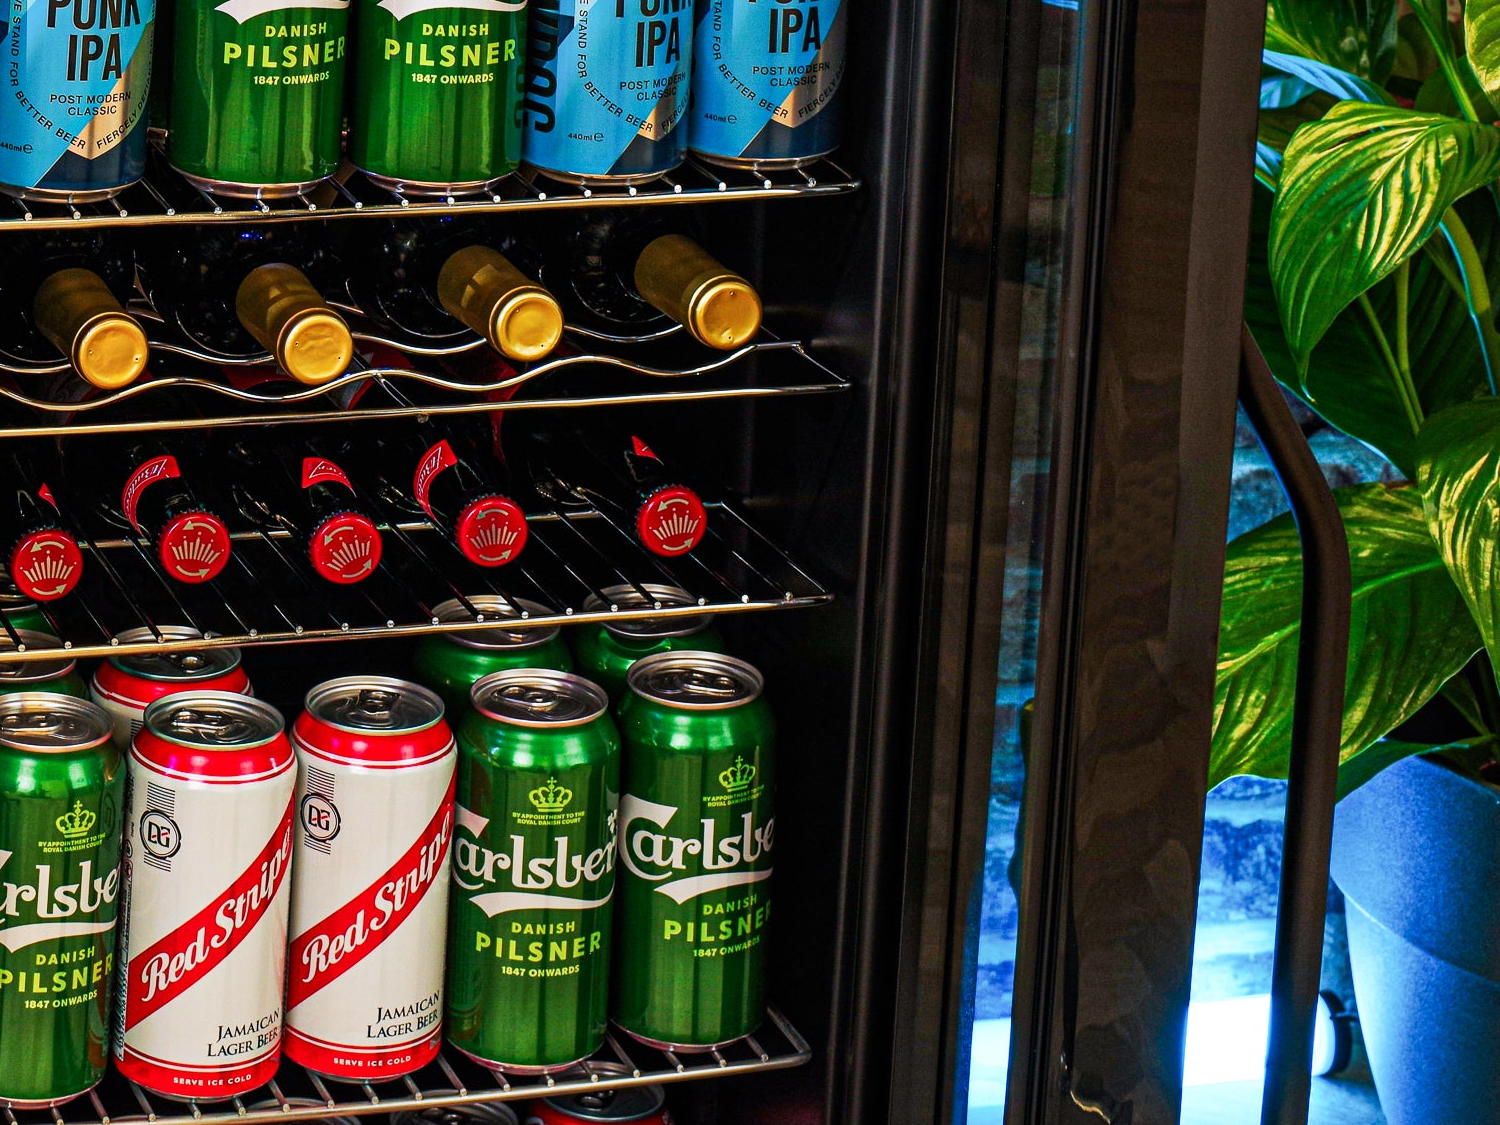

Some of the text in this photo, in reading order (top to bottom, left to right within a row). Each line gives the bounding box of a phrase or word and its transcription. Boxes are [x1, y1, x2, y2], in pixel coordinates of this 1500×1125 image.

[11, 16, 21, 57] STAND
[265, 22, 327, 37] DANISH
[422, 23, 489, 37] DANISH
[578, 10, 588, 49] STAND
[768, 6, 821, 53] IPA
[223, 35, 345, 68] PILSNER
[384, 38, 516, 68] PILSNER
[635, 18, 680, 67] IPA
[66, 33, 122, 81] IPA
[577, 53, 587, 79] FOR
[752, 66, 784, 75] POST
[787, 62, 830, 75] MODERN
[9, 61, 19, 87] FOR
[253, 71, 330, 85] 1847 ONWARDS
[411, 73, 494, 84] 1847 ONWARDS
[620, 80, 649, 90] POST
[712, 35, 721, 61] FOR
[719, 63, 756, 101] BETTER
[758, 98, 789, 119] BEER
[770, 75, 817, 87] CLASSIC
[50, 91, 131, 104] POST MODERN
[584, 81, 623, 118] BETTER
[637, 87, 677, 101] CLASSIC
[798, 78, 836, 118] FIERCELY
[15, 90, 53, 131] BETTER
[67, 105, 117, 116] CLASSIC
[704, 113, 726, 122] 440ml
[96, 110, 137, 149] FIERCELY
[625, 113, 654, 132] BEER
[0, 141, 22, 152] 440ml
[55, 128, 86, 150] BEER
[567, 132, 592, 141] 440ml
[47, 838, 89, 847] APPOINTMENT
[452, 801, 617, 889] Carlsber
[618, 793, 775, 881] Carlsbe
[302, 811, 450, 983] Red Stripe
[703, 893, 757, 916] DANISH
[141, 826, 291, 1002] Red Stripe
[511, 921, 575, 935] DANISH
[36, 946, 95, 965] DANISH
[475, 931, 601, 962] PILSNER
[693, 935, 761, 957] 1847 ONWARDS
[501, 964, 580, 977] 1847 ONWARDS
[24, 989, 98, 1009] 1847 ONWARDS
[376, 989, 440, 1024] JAMAICAN
[216, 1007, 280, 1043] JAMAICAN
[366, 1009, 438, 1038] LAGER BEER
[207, 1027, 278, 1057] LAGER BEER
[333, 1057, 363, 1067] SERVE
[387, 1055, 411, 1066] COLD
[173, 1077, 203, 1086] SERVE
[227, 1074, 252, 1085] COLD
